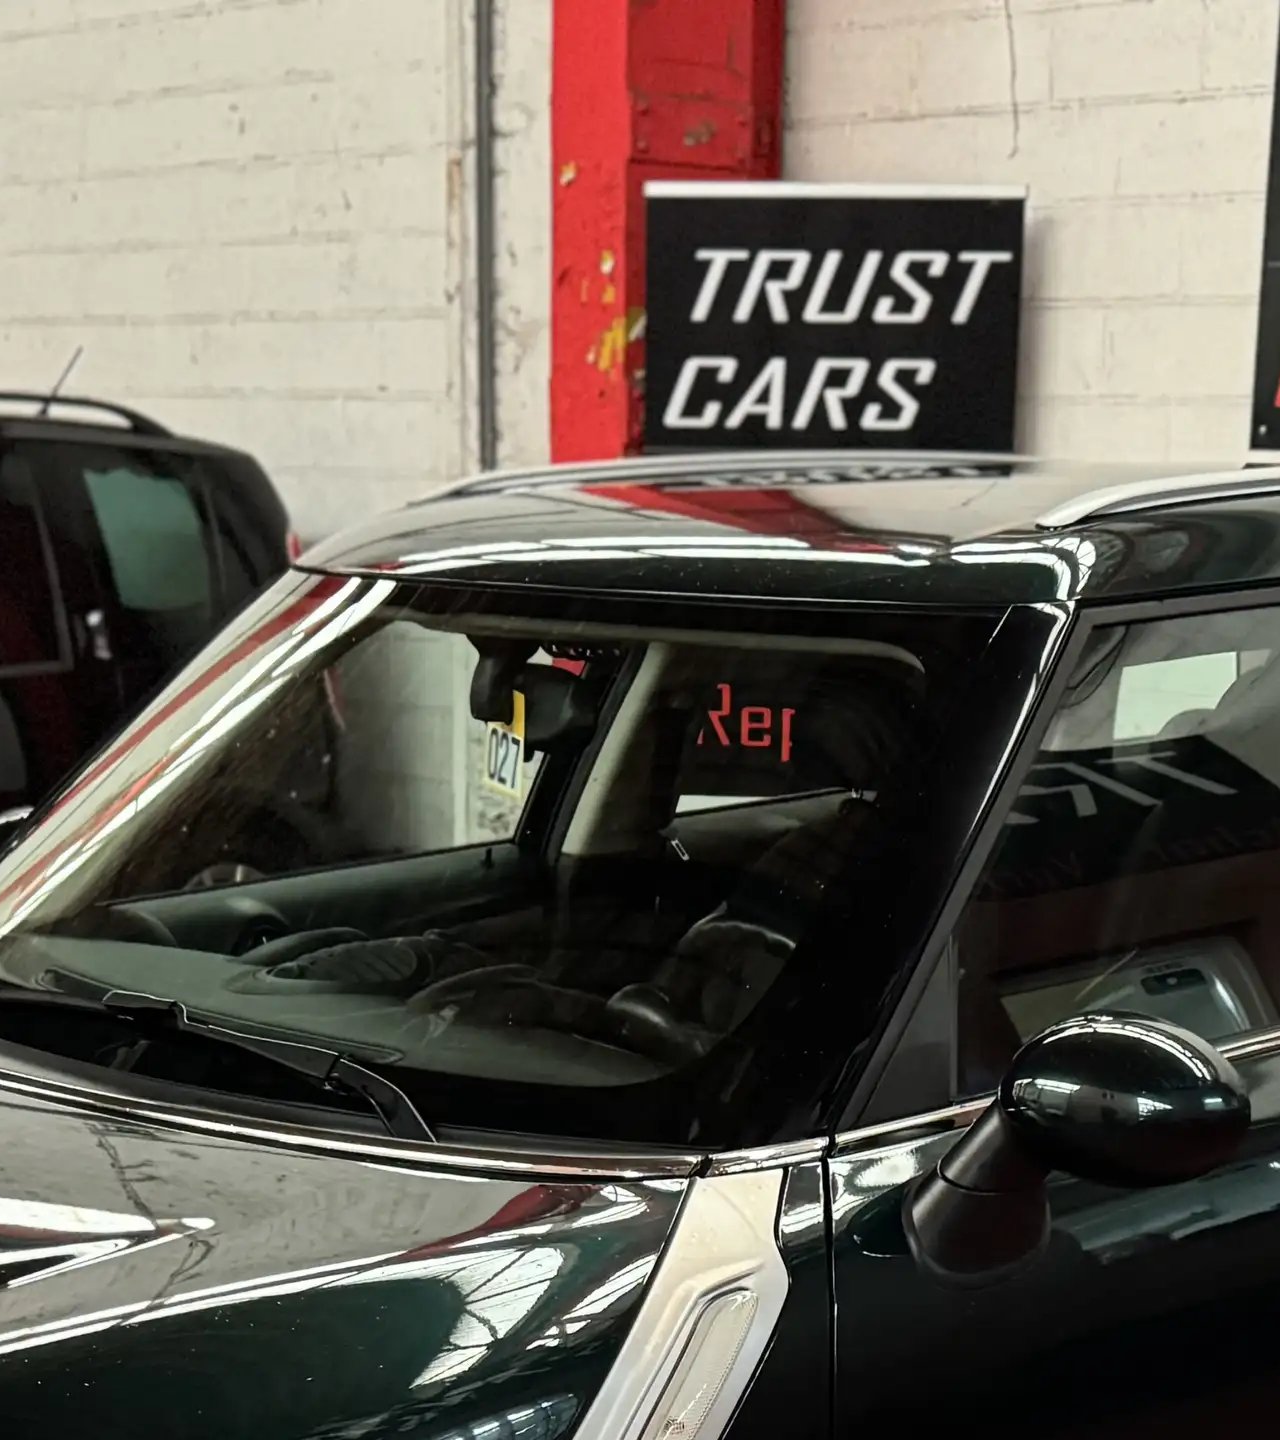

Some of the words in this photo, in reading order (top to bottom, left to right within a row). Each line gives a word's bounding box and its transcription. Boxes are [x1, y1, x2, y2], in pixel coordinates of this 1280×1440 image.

[690, 248, 1014, 324] TRUST
[662, 356, 937, 430] CARS
[487, 727, 521, 789] 027
